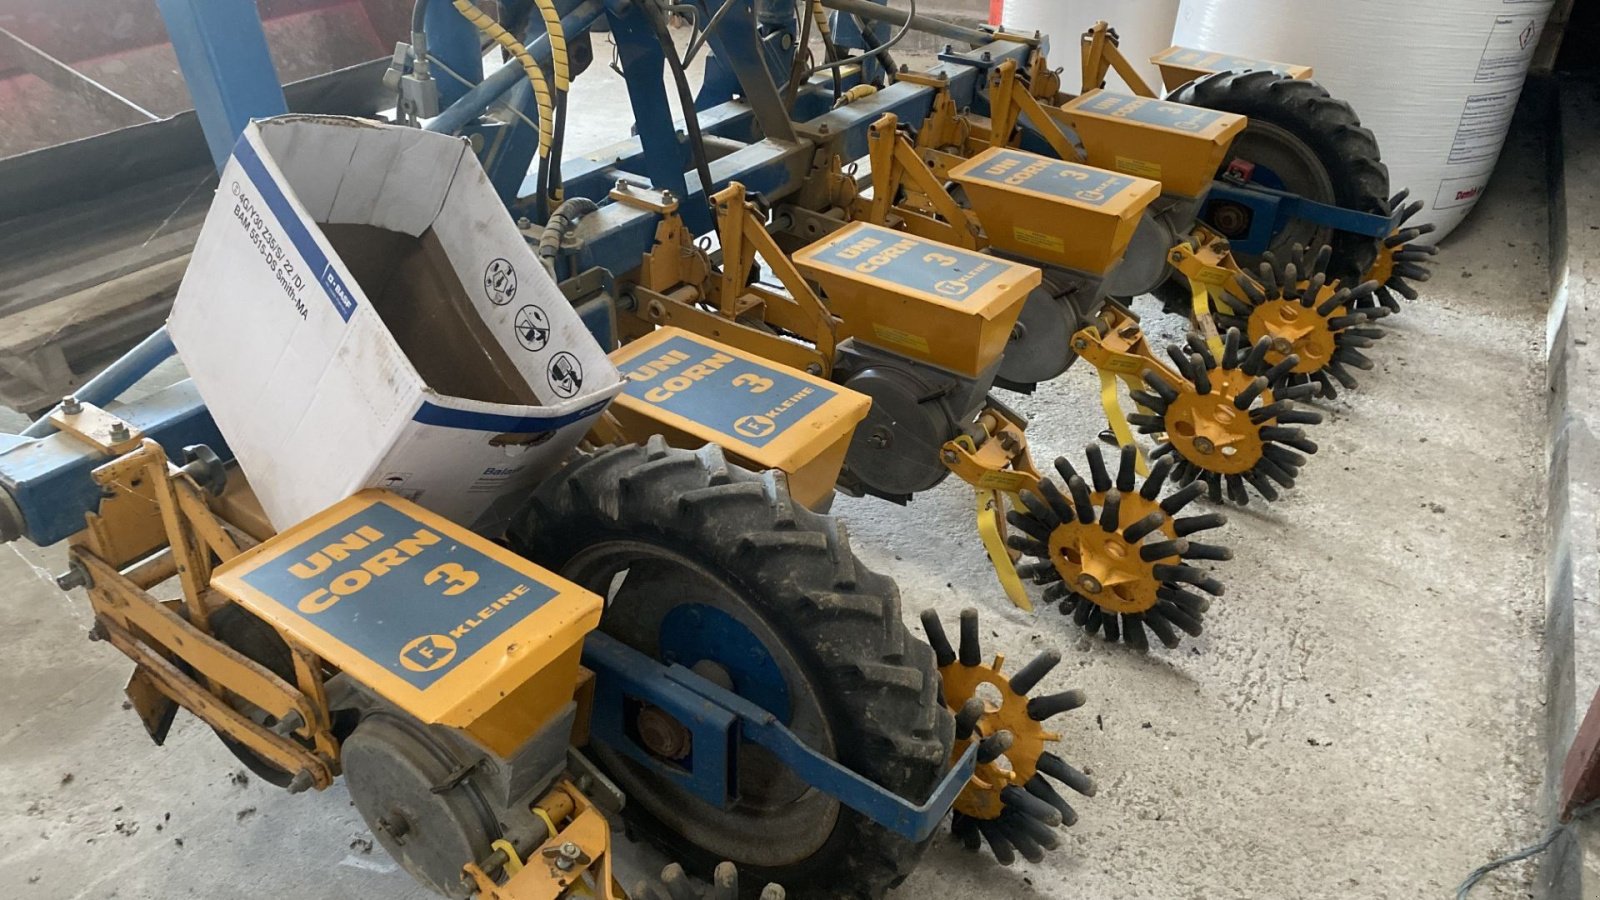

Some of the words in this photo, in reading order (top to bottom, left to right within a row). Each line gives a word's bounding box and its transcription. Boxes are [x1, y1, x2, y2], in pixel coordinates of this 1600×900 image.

[985, 158, 1021, 176] UNI
[1059, 169, 1089, 181] 3
[239, 193, 263, 230] 4G/Y30
[261, 226, 285, 261] Z35/S/
[283, 259, 294, 276] 22
[294, 272, 306, 292] /D/
[835, 237, 883, 259] UNI
[855, 239, 919, 273] CORN
[233, 204, 252, 232] BAM
[249, 228, 277, 272] 5515-DS
[275, 268, 309, 320] Smith-MA
[923, 252, 957, 267] 3
[334, 283, 352, 309] BASF
[630, 350, 691, 382] UNI
[644, 352, 735, 403] CORN
[731, 373, 774, 394] 3
[766, 387, 815, 419] KLEINE
[287, 525, 385, 579] UNI
[297, 528, 442, 614] CORN
[424, 562, 480, 596] 3
[449, 584, 531, 639] KLEINE
